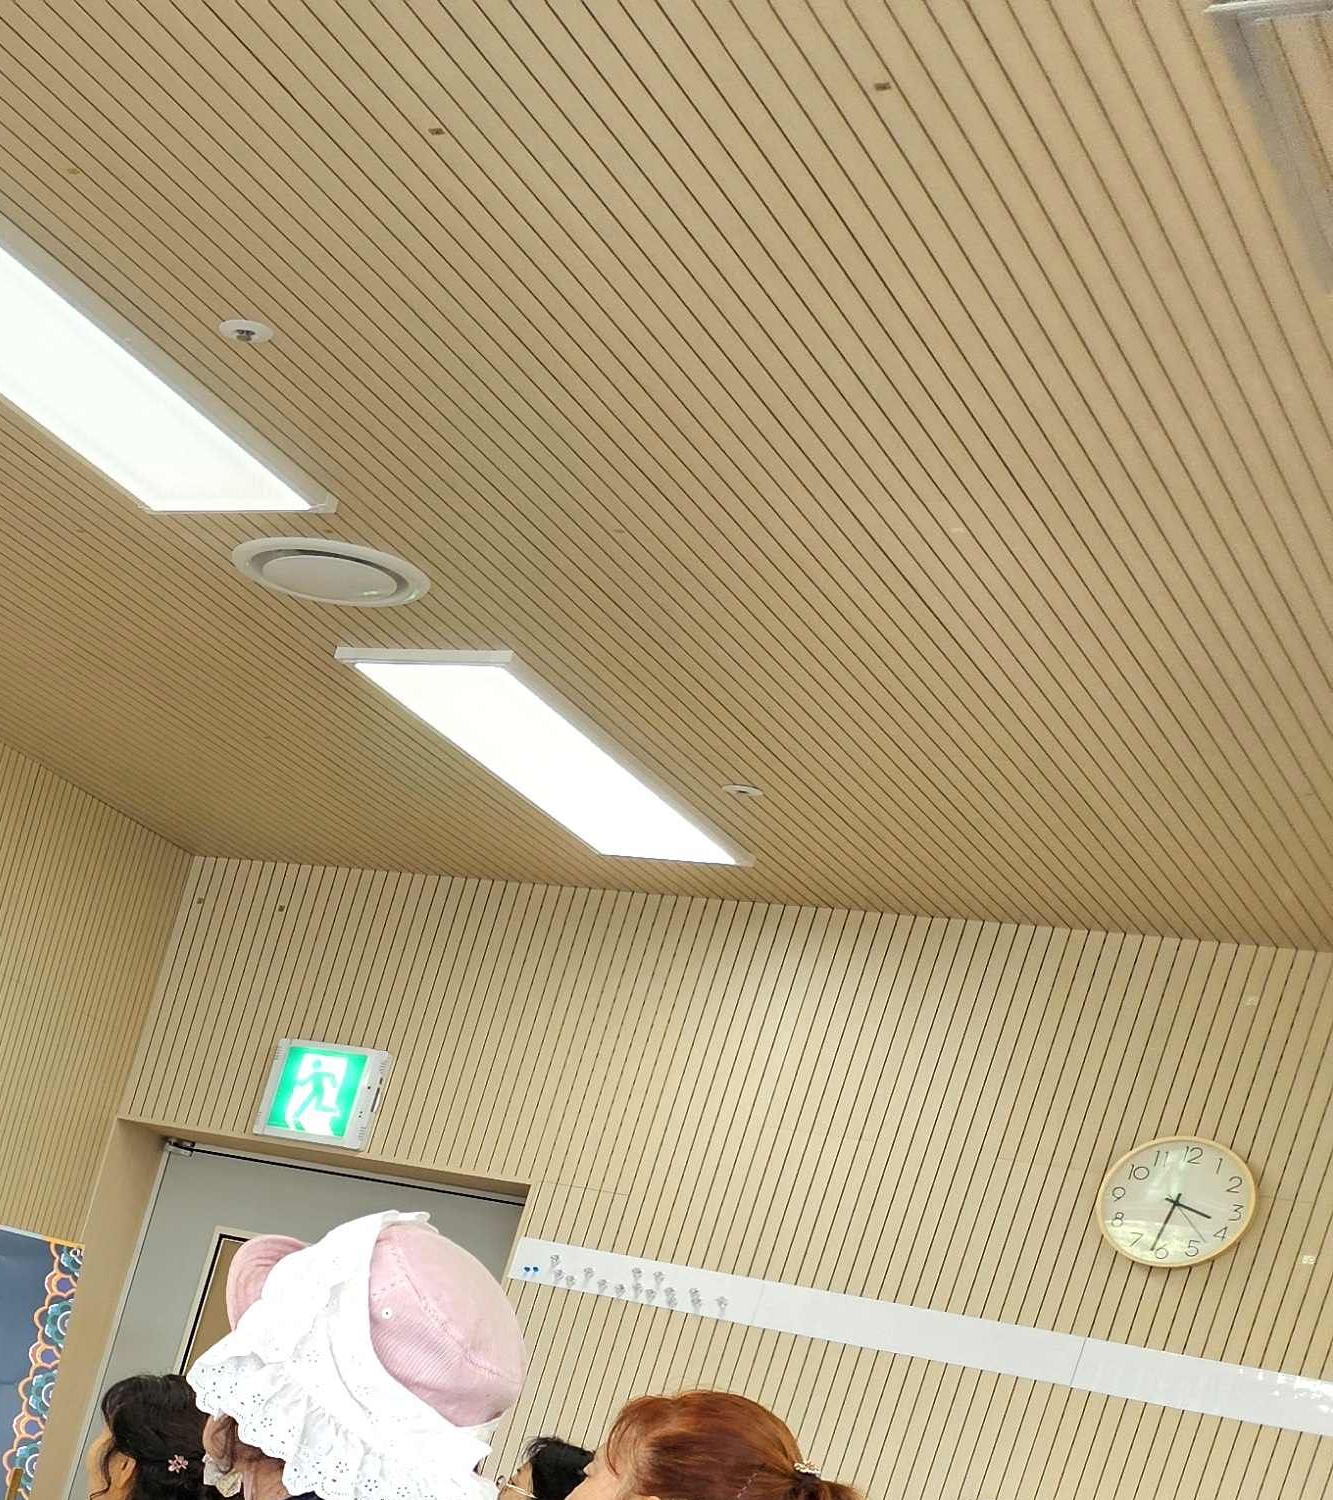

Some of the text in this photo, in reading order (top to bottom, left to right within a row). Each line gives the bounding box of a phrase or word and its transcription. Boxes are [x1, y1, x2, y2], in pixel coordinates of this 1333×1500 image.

[1183, 1146, 1204, 1165] 12
[1128, 1164, 1150, 1180] 10
[1226, 1176, 1243, 1193] 2
[1112, 1186, 1126, 1202] 9
[1111, 1212, 1124, 1228] 8
[1228, 1204, 1244, 1221] 3
[1129, 1232, 1144, 1247] 7
[1213, 1226, 1228, 1242] 4
[1154, 1244, 1169, 1260] 6
[1185, 1240, 1201, 1257] 5
